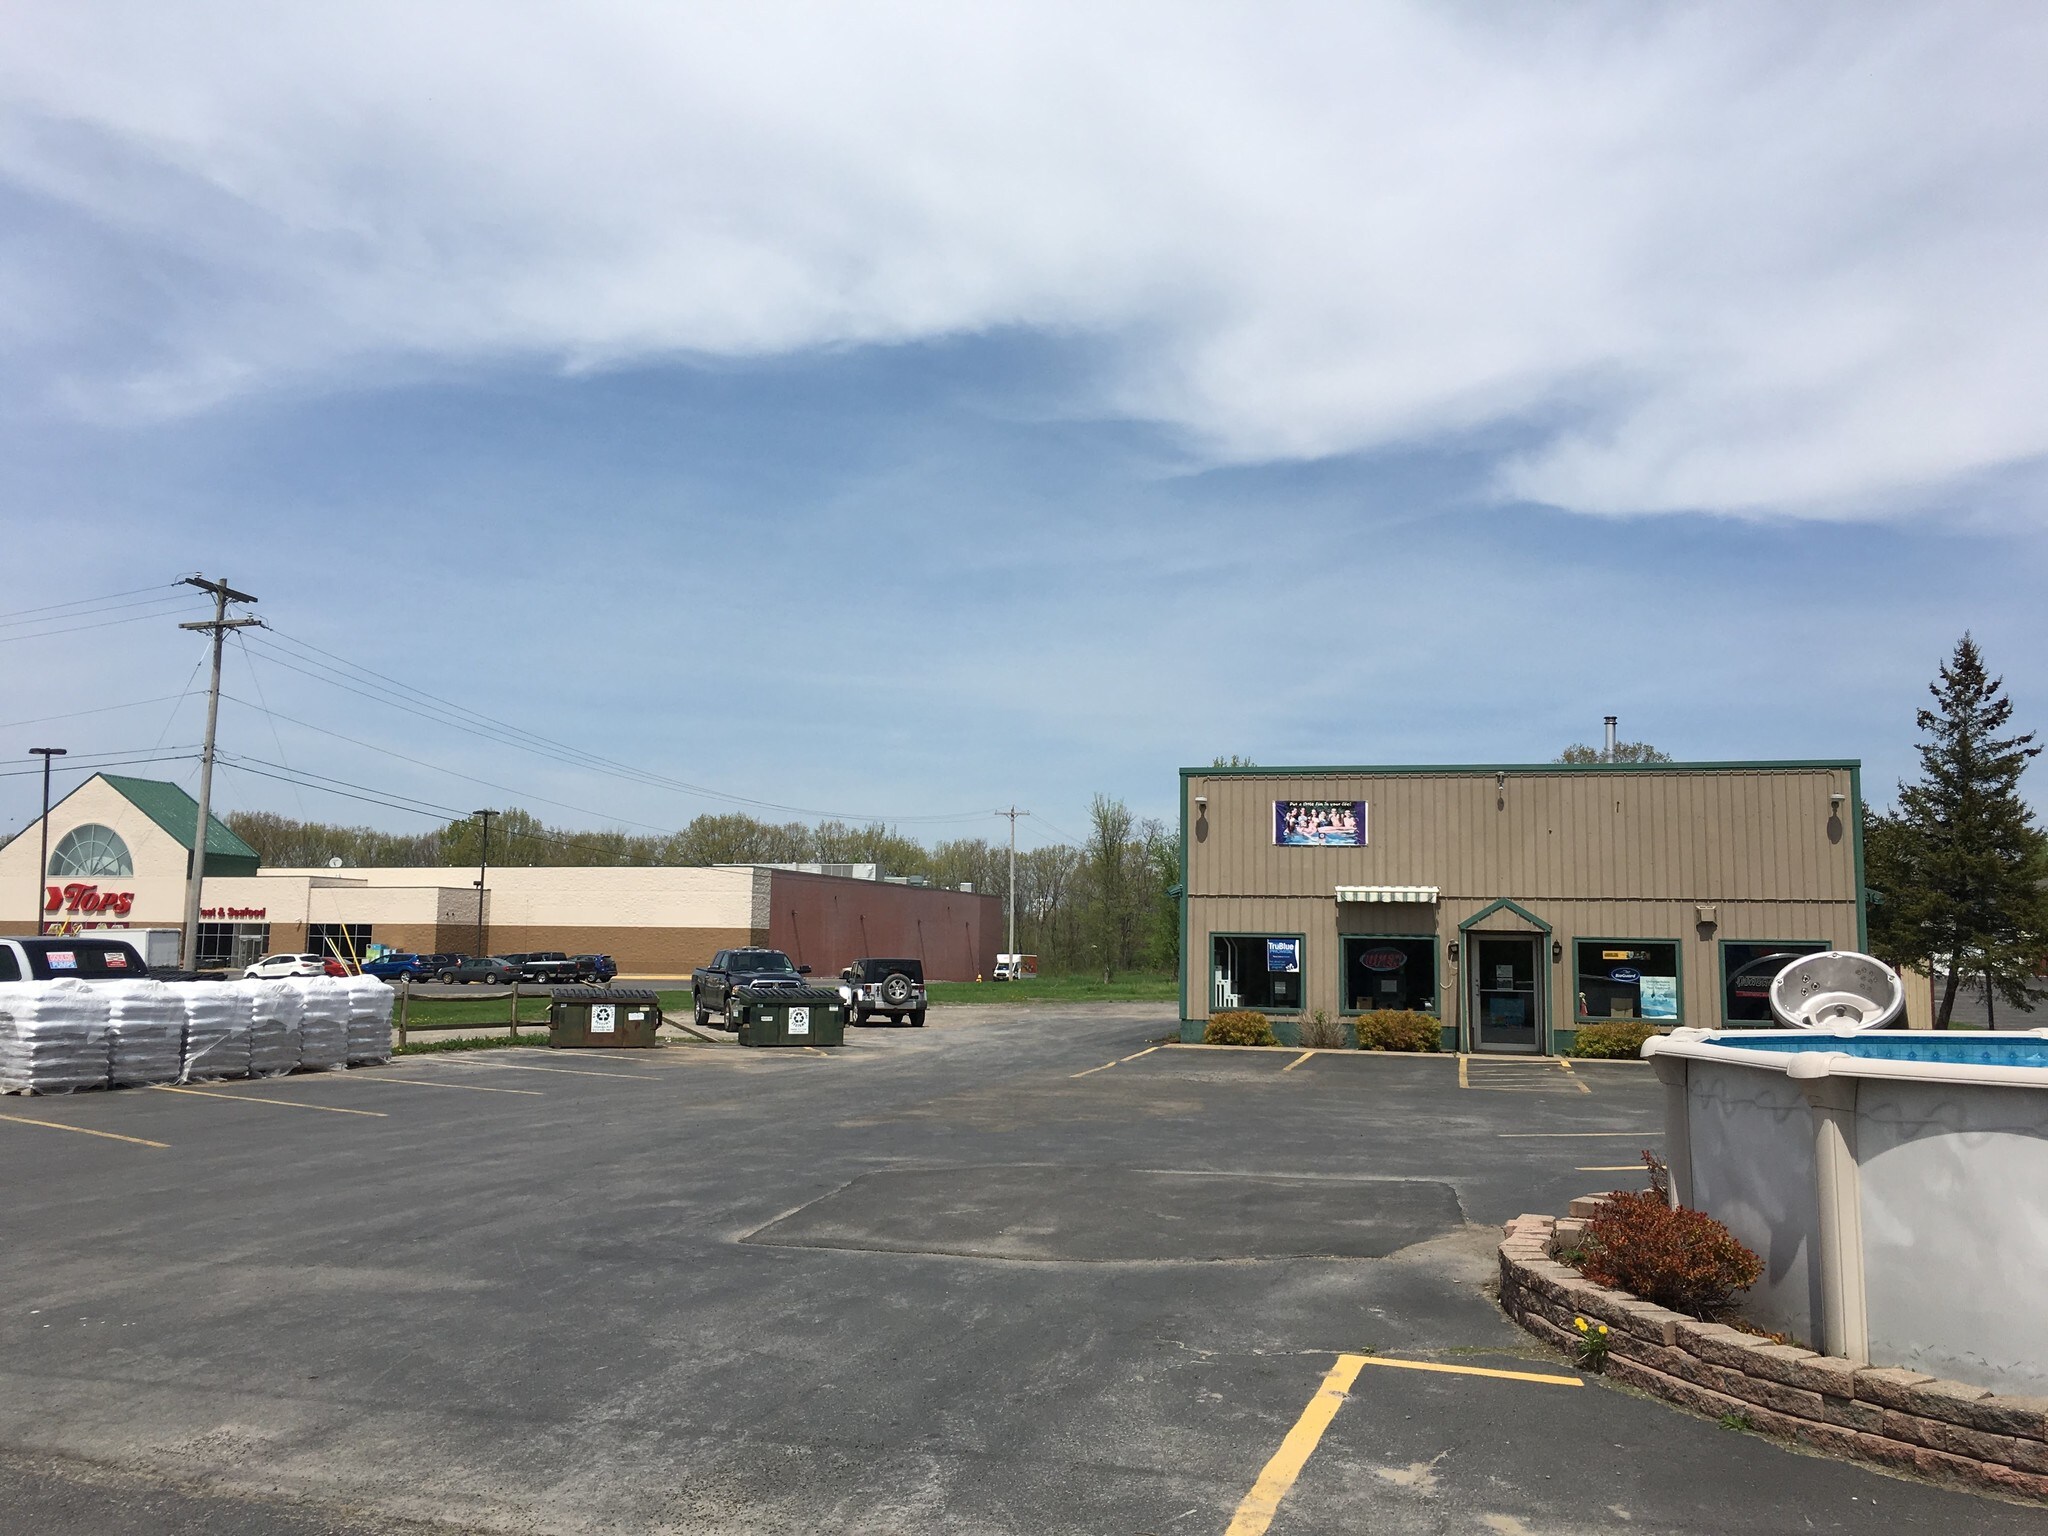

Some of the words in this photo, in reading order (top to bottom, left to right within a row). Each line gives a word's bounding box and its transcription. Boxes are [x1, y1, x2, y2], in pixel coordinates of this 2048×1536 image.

[200, 907, 216, 917] eat
[218, 907, 225, 917] &
[227, 907, 266, 917] Seafood
[1268, 942, 1294, 950] TruBlue
